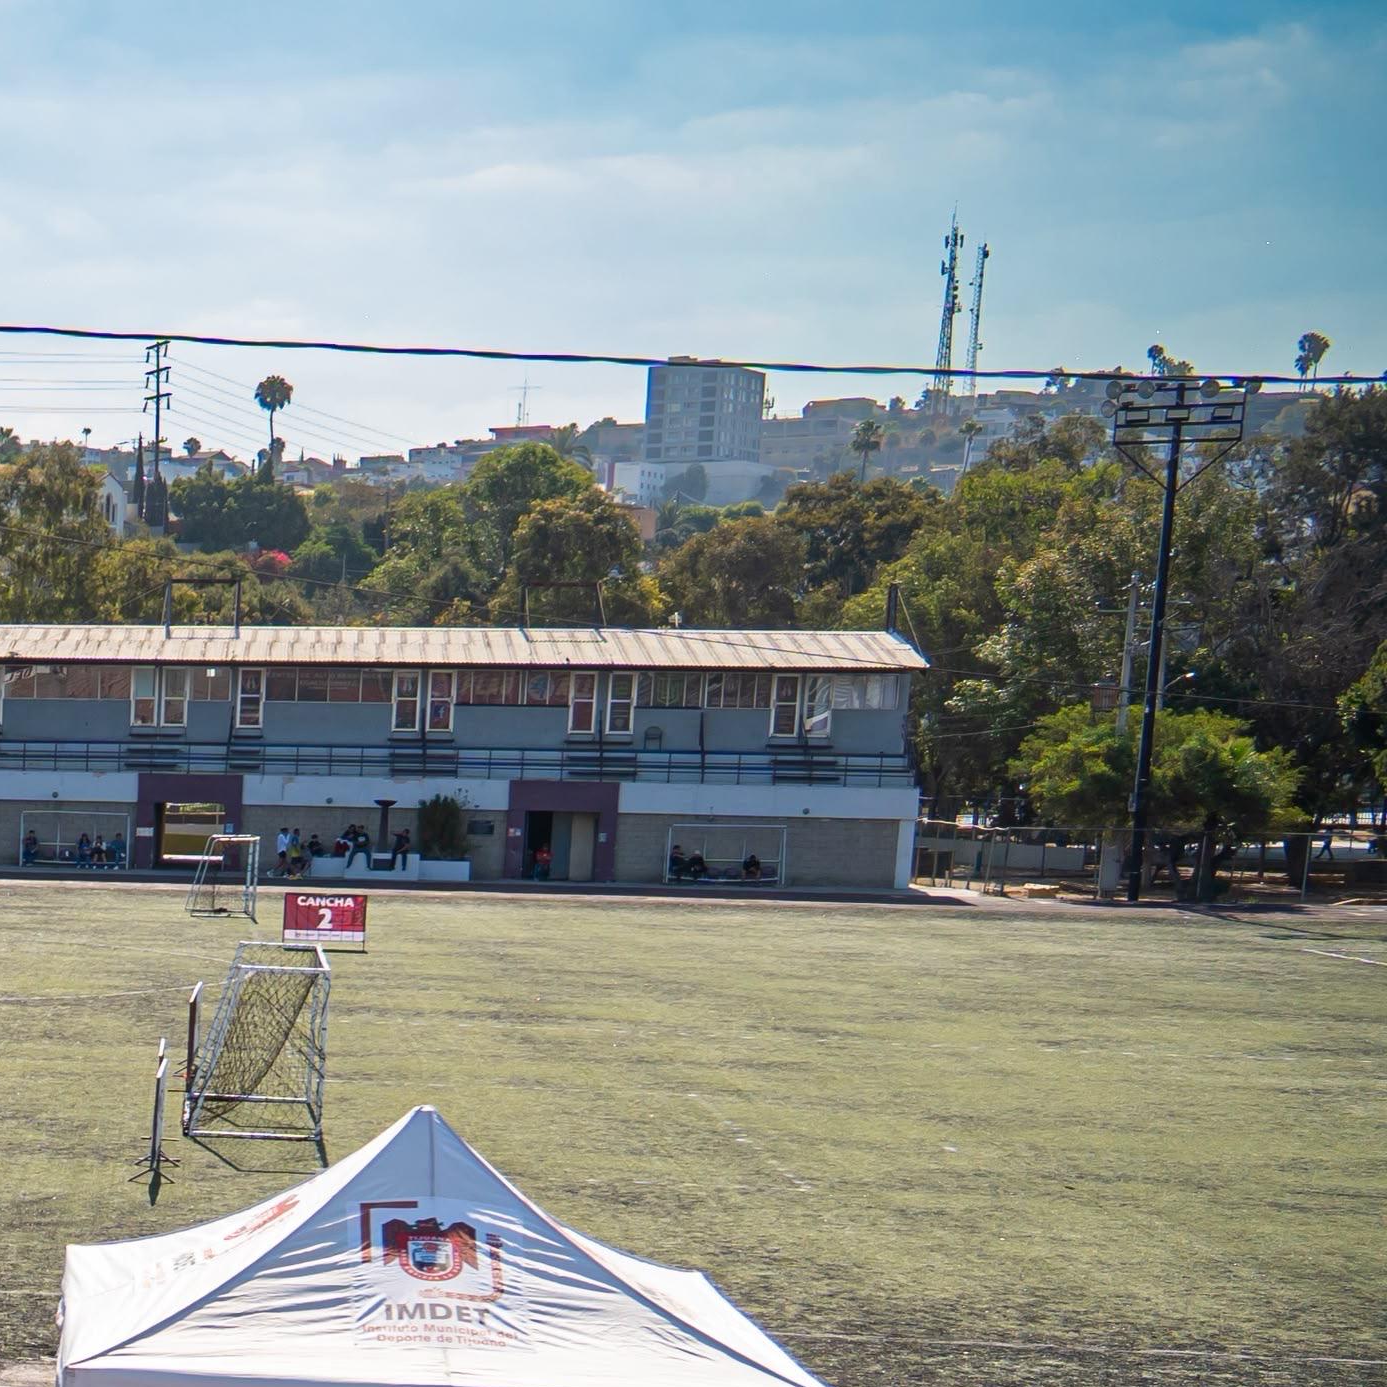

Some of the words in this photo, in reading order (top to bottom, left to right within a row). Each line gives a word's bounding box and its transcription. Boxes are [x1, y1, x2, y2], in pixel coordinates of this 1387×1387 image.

[297, 896, 354, 907] CANCHA
[317, 908, 333, 929] 2
[386, 1304, 490, 1324] IMDET
